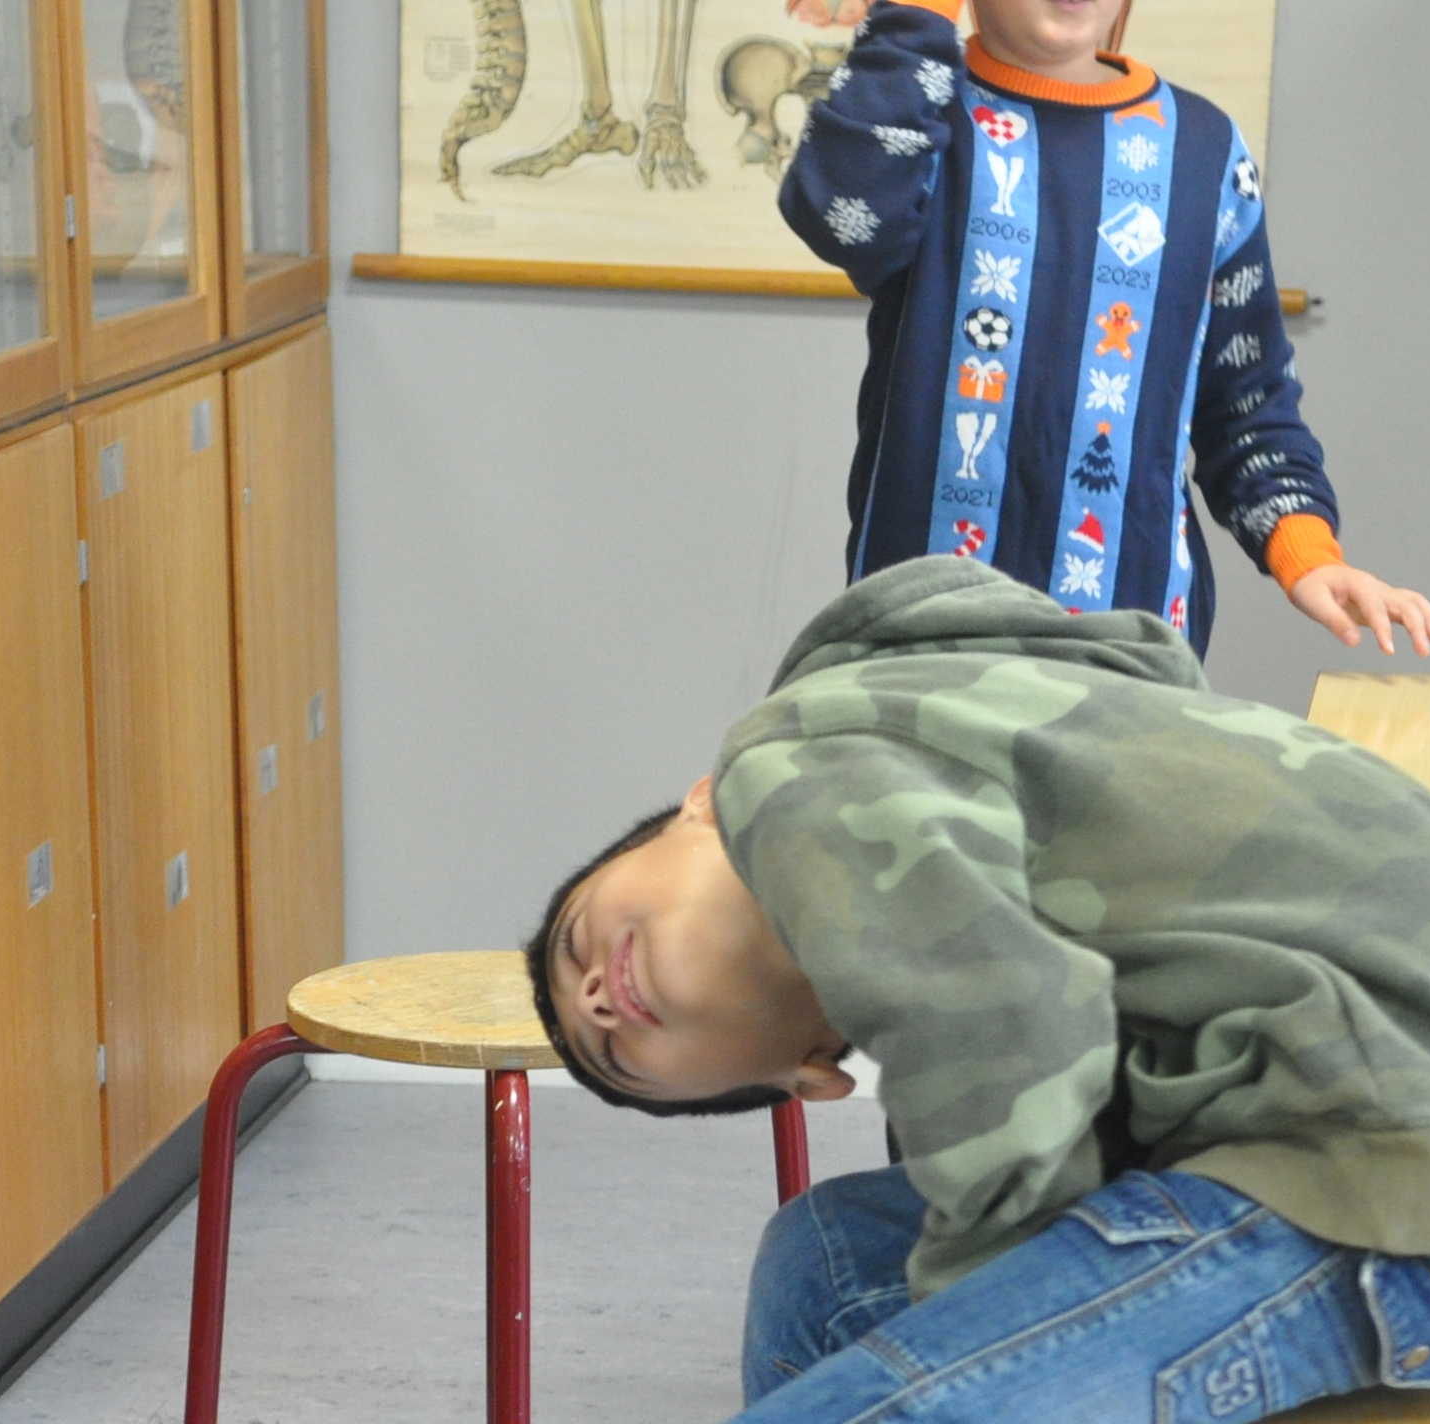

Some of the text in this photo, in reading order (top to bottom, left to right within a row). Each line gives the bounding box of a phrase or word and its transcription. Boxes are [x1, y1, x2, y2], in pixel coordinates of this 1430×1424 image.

[1106, 178, 1162, 202] 2003
[970, 216, 1031, 245] 2006
[940, 483, 993, 508] 2021
